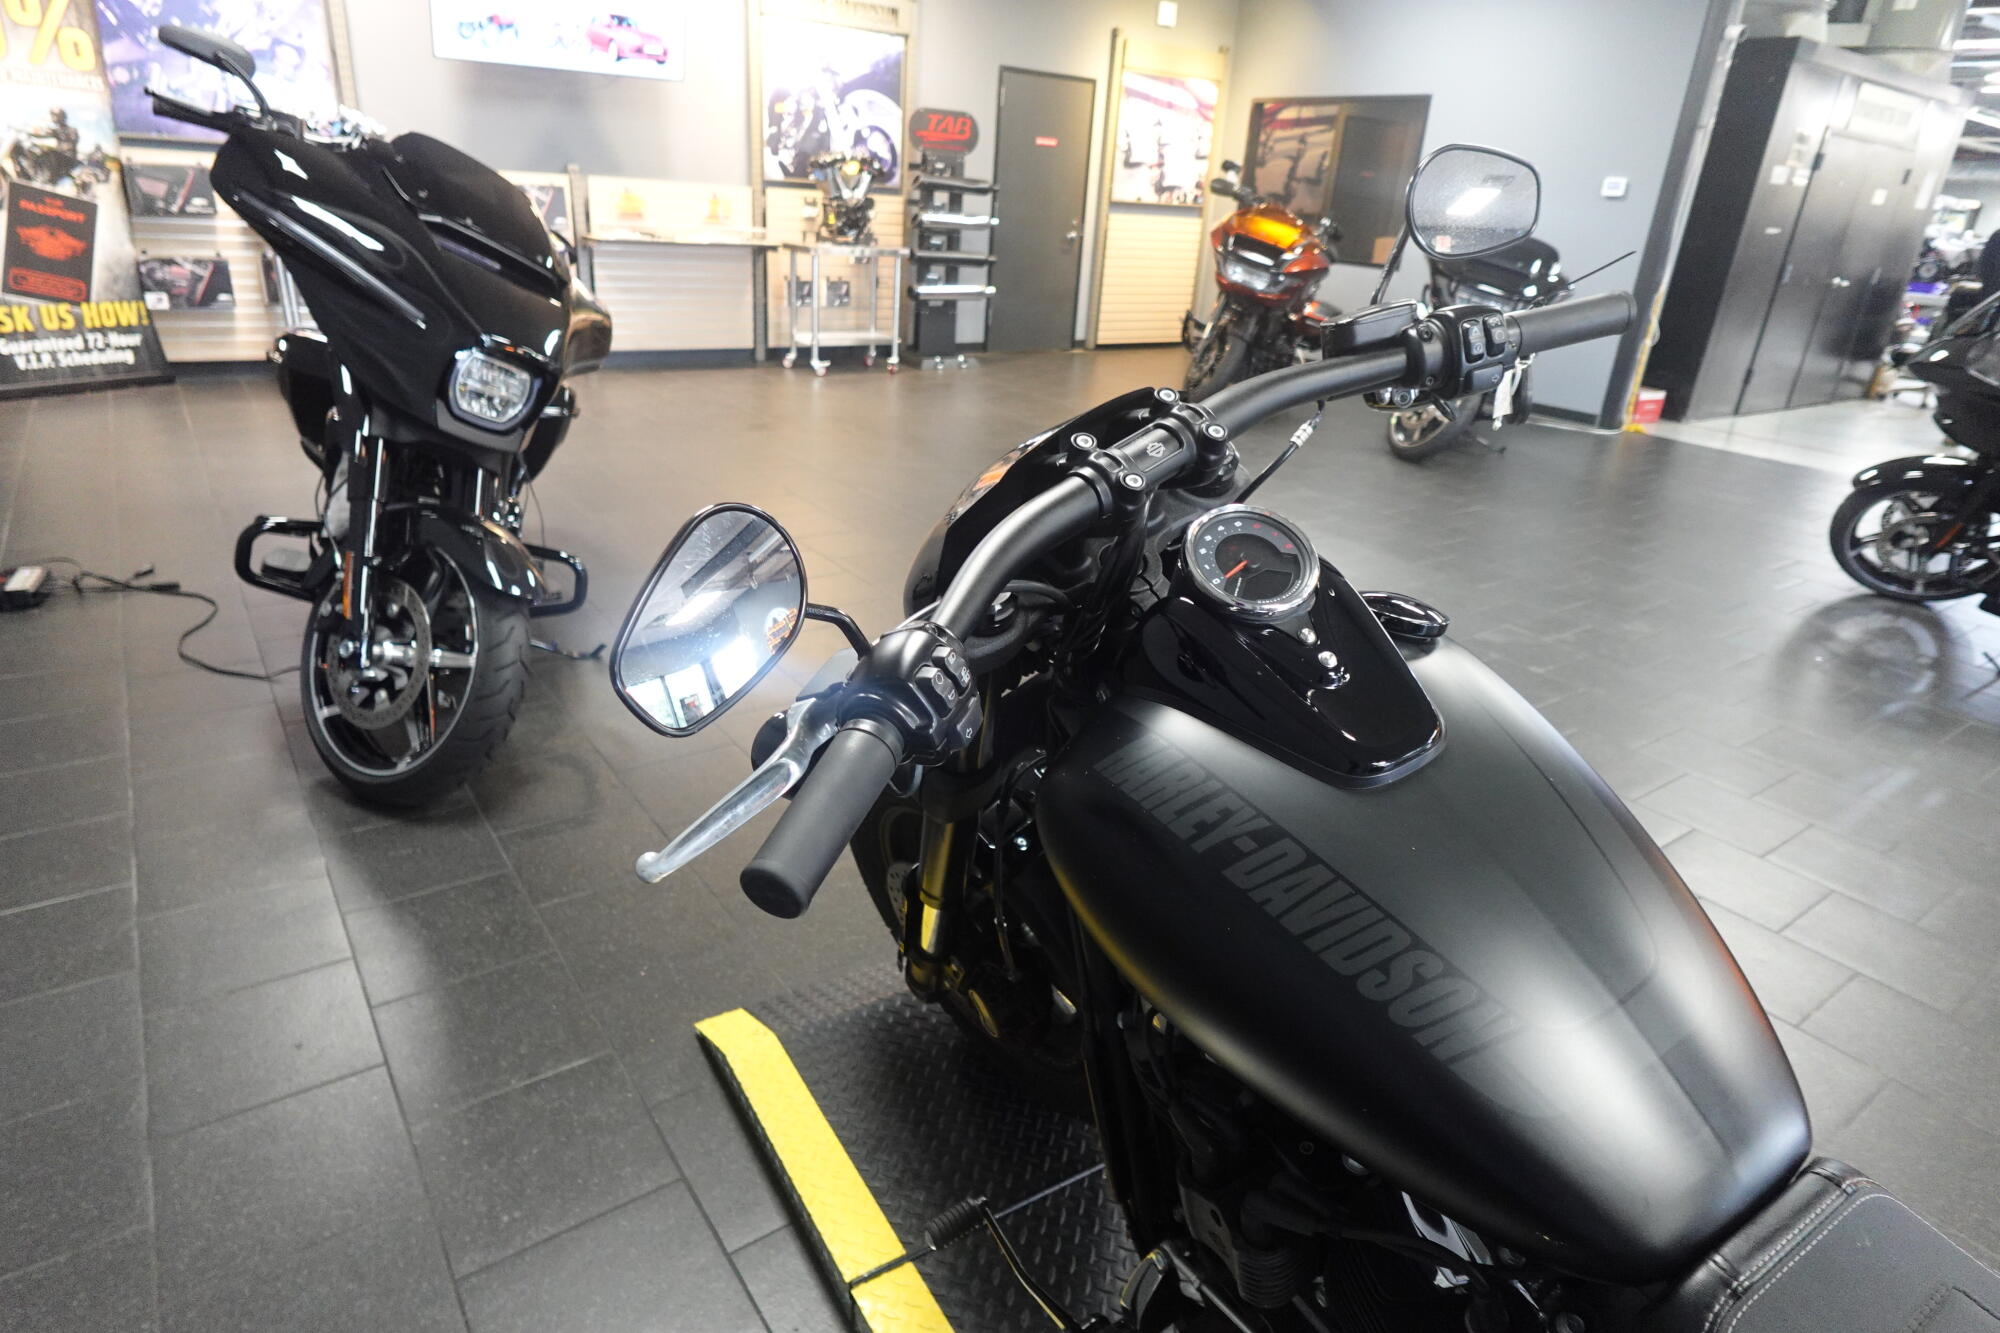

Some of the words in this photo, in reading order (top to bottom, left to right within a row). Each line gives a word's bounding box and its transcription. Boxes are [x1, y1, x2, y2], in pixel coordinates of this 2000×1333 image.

[927, 113, 973, 139] TAB
[39, 302, 76, 331] US
[80, 300, 149, 329] HOW!
[1093, 733, 1518, 1063] HARLEY-DAVIDSON
